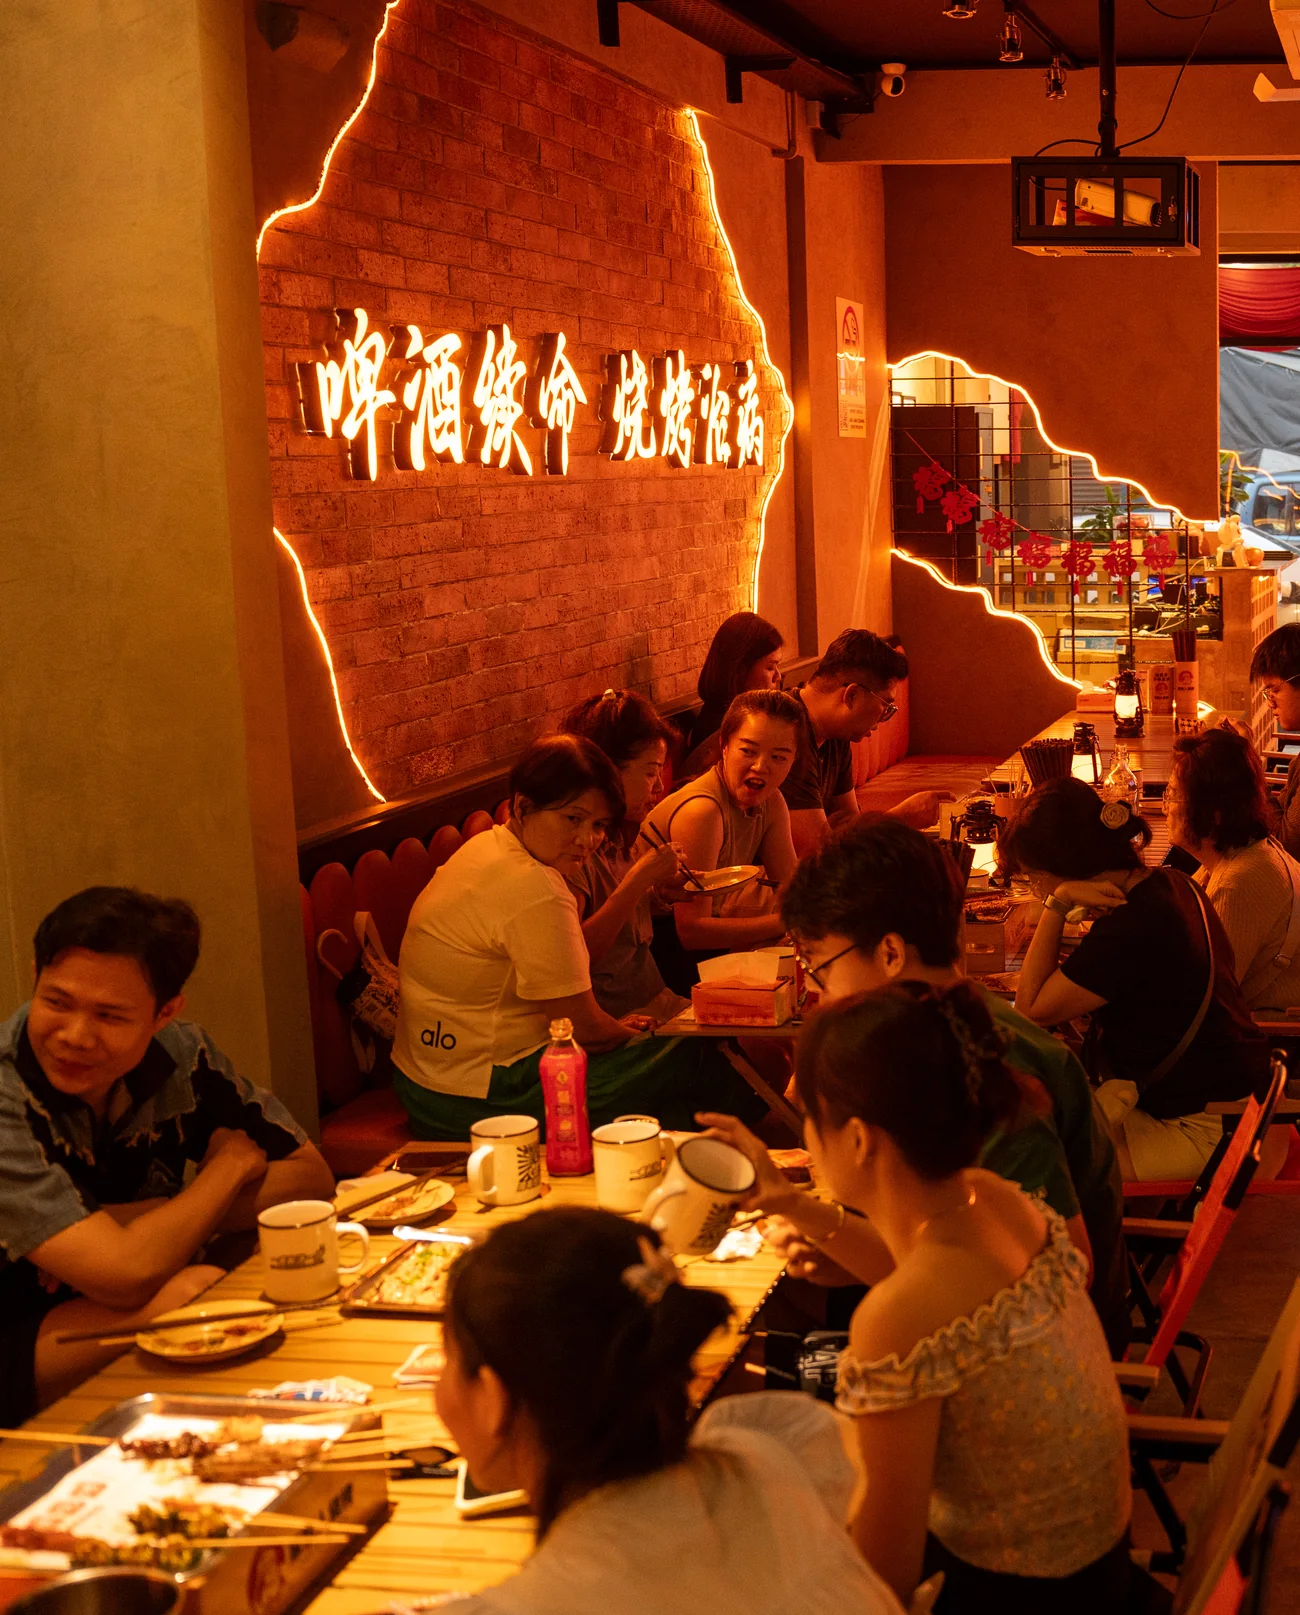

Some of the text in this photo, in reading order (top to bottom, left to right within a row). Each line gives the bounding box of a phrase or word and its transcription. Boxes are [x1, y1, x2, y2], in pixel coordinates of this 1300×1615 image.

[1061, 539, 1096, 577] 福
[1102, 540, 1137, 577] 福
[420, 1020, 457, 1050] alo
